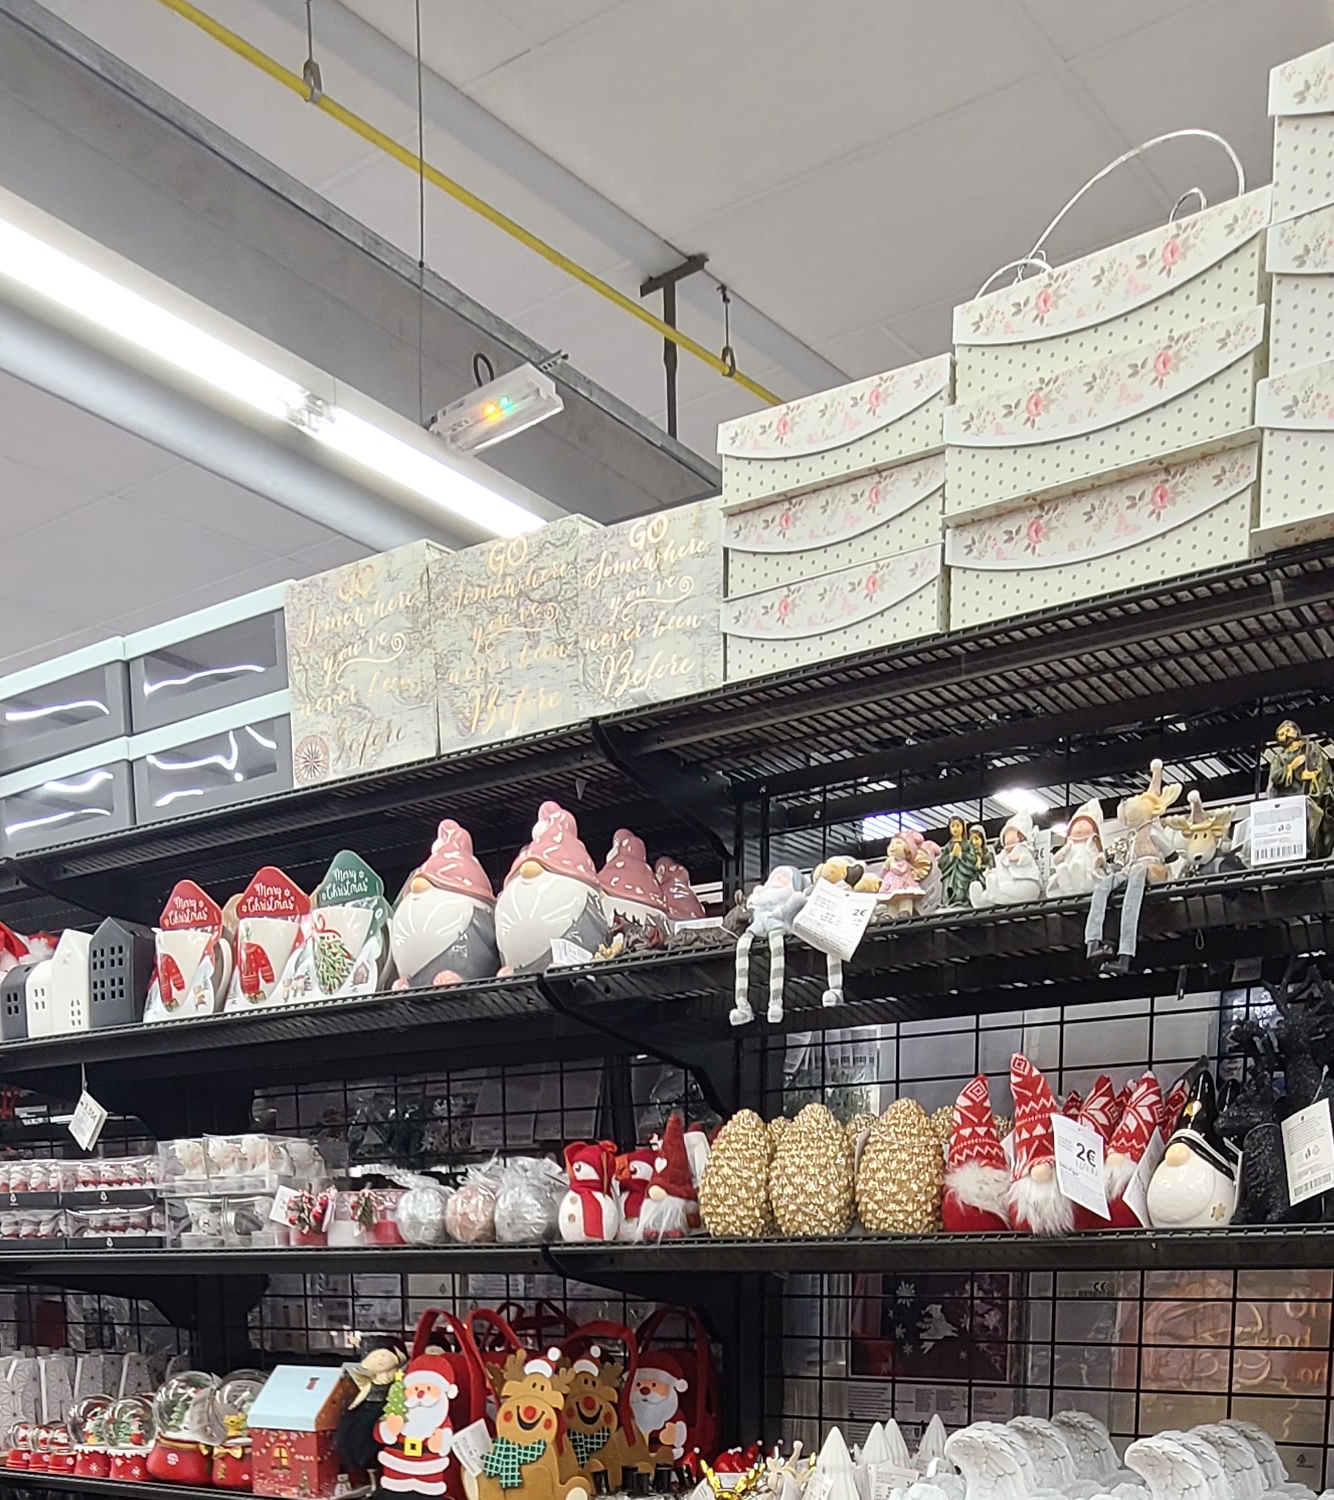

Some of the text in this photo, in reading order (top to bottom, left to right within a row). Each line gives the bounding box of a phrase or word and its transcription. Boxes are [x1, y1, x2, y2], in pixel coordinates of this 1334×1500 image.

[629, 515, 668, 550] GO
[488, 536, 528, 576] GO
[584, 539, 710, 590] Somewhere
[337, 564, 376, 603] GO
[445, 561, 575, 618] Somewhere
[609, 574, 680, 626] you've
[302, 591, 415, 648] Somewhere
[585, 610, 703, 650] never been
[447, 655, 510, 685] never
[600, 650, 695, 697] Before
[300, 684, 356, 716] never
[470, 683, 563, 735] Before
[331, 716, 407, 768] Before
[255, 883, 283, 898] Merry
[326, 878, 369, 900] Christmas
[333, 867, 357, 882] Merry
[168, 909, 209, 926] Christmas
[174, 896, 197, 911] Merry
[246, 896, 295, 913] Christmas
[1076, 1142, 1096, 1168] 2€
